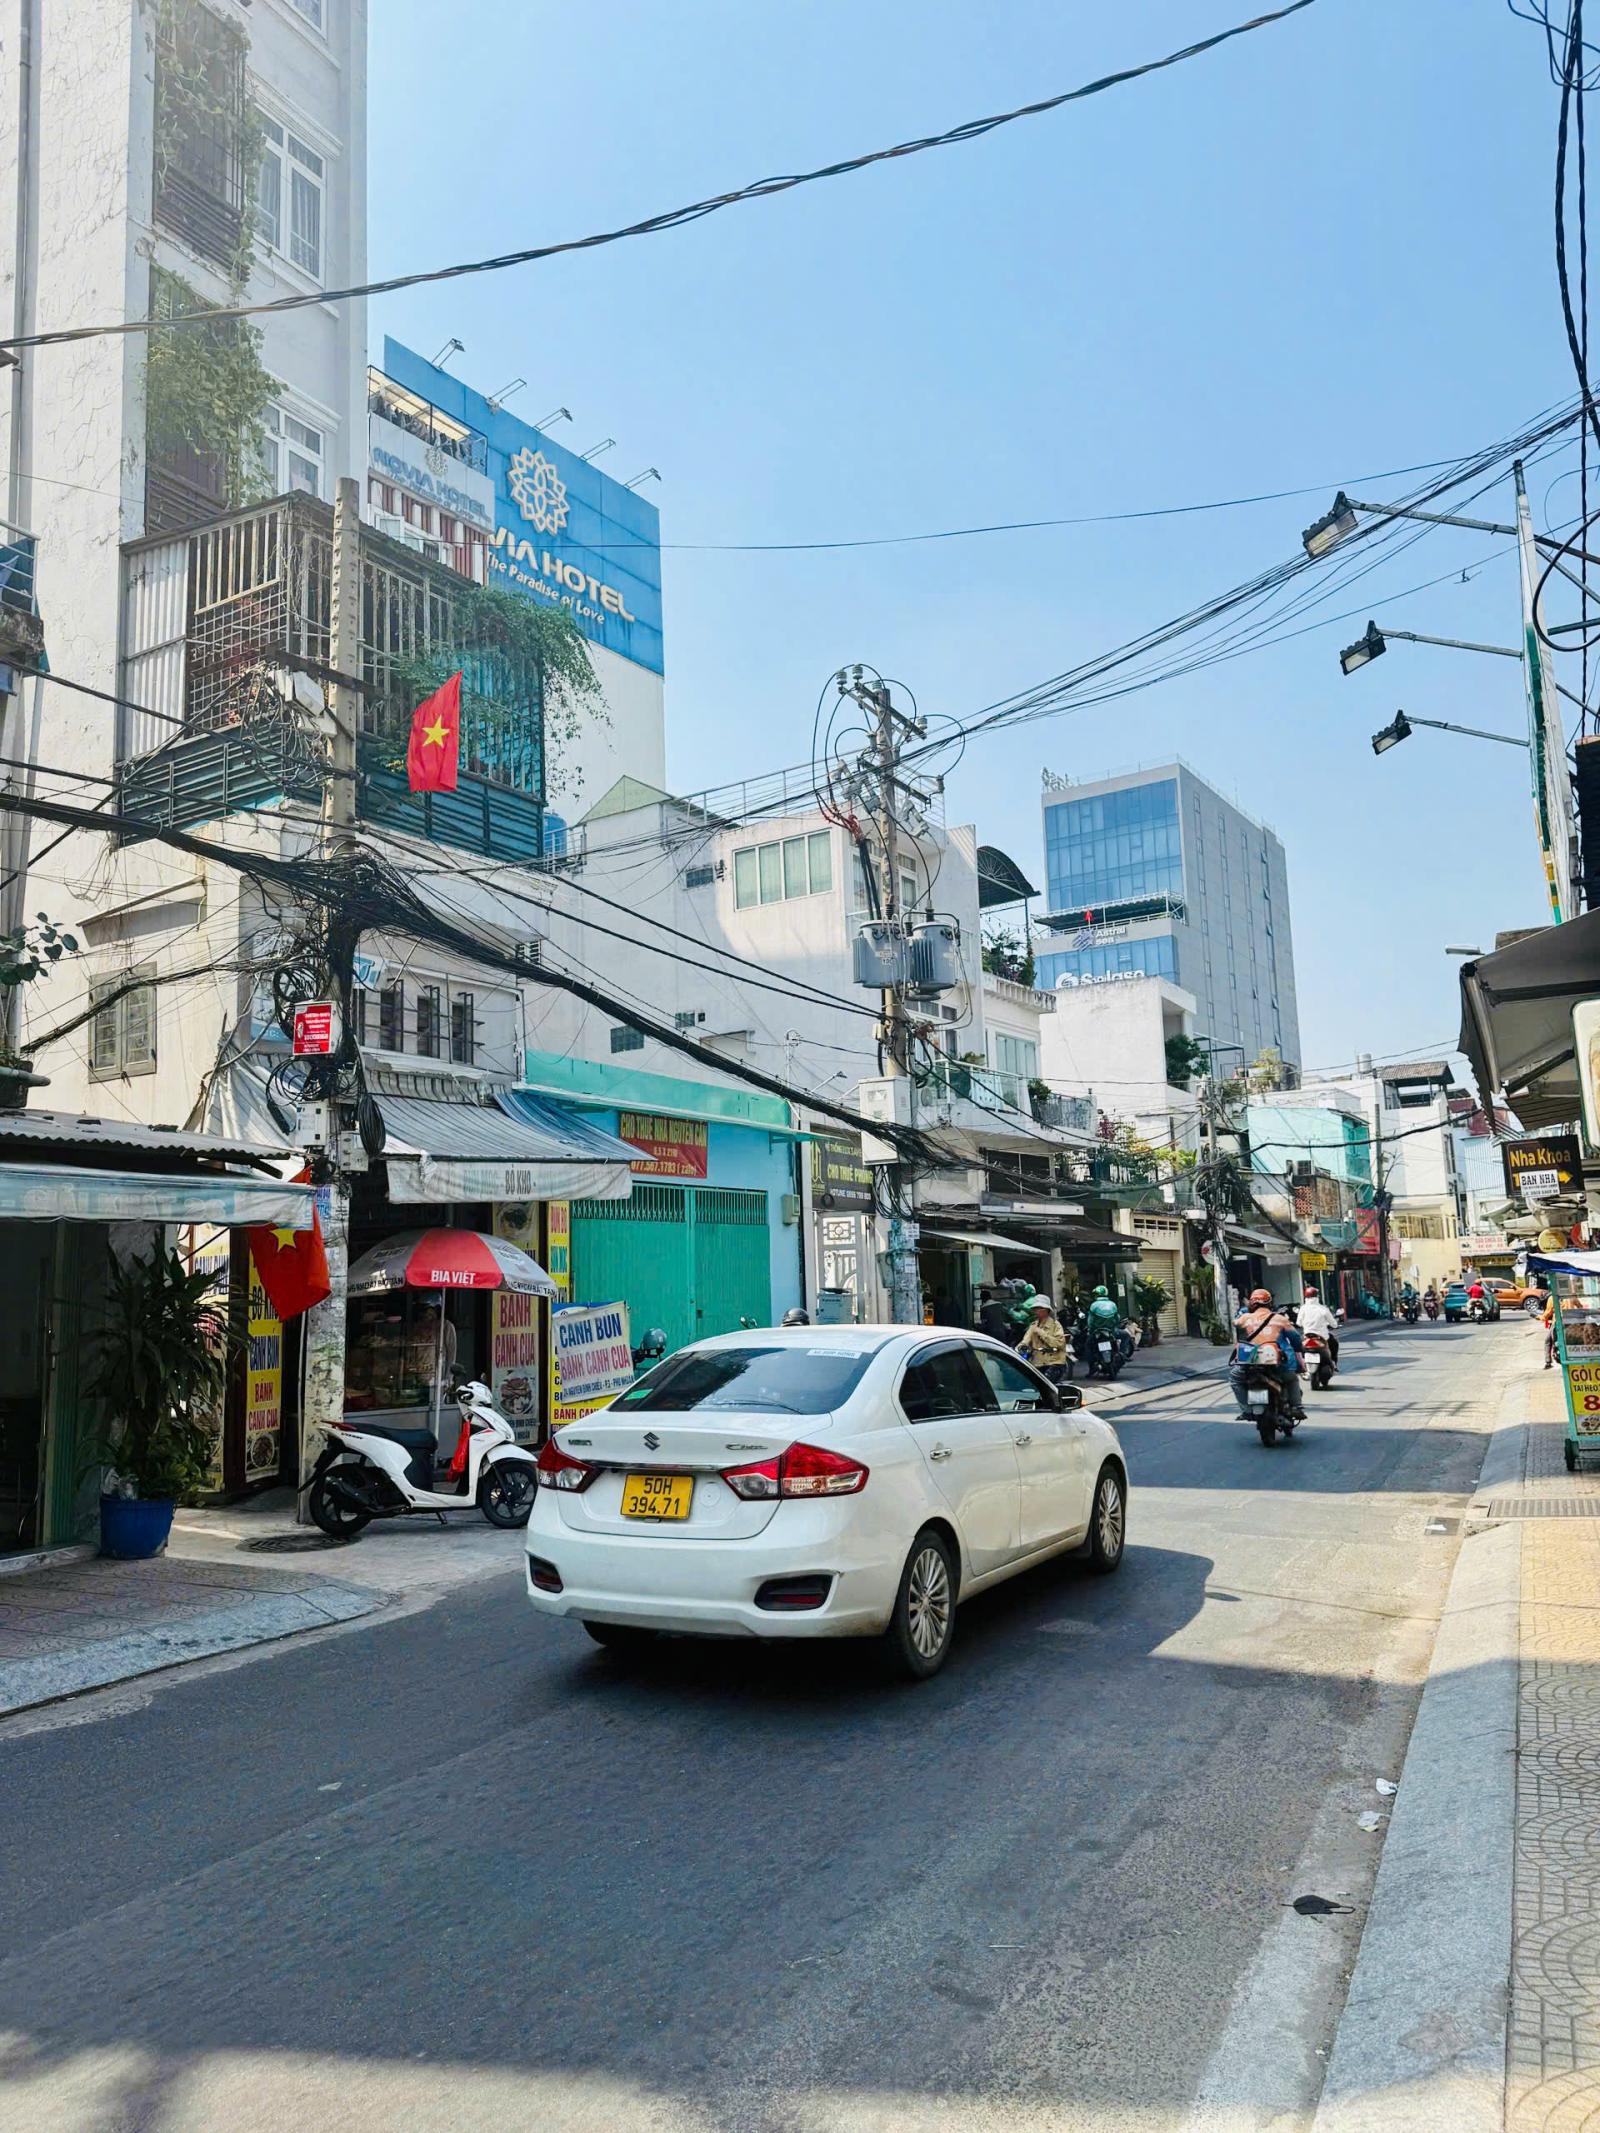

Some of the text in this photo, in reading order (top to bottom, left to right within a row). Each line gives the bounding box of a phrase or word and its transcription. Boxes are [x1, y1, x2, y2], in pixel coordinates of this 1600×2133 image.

[509, 564, 560, 600] Paradise
[576, 599, 605, 624] Love
[542, 551, 636, 622] HOTEL
[1509, 1148, 1571, 1167] Nha Khoa
[431, 1270, 450, 1282] BIA
[560, 1320, 593, 1348] CANH
[495, 1333, 535, 1368] CANH CUA
[585, 1348, 610, 1375] CANH
[611, 1344, 630, 1369] CUA
[249, 1408, 278, 1432] CANH CUA
[643, 1477, 673, 1495] 50H
[628, 1496, 680, 1515] 394.71
